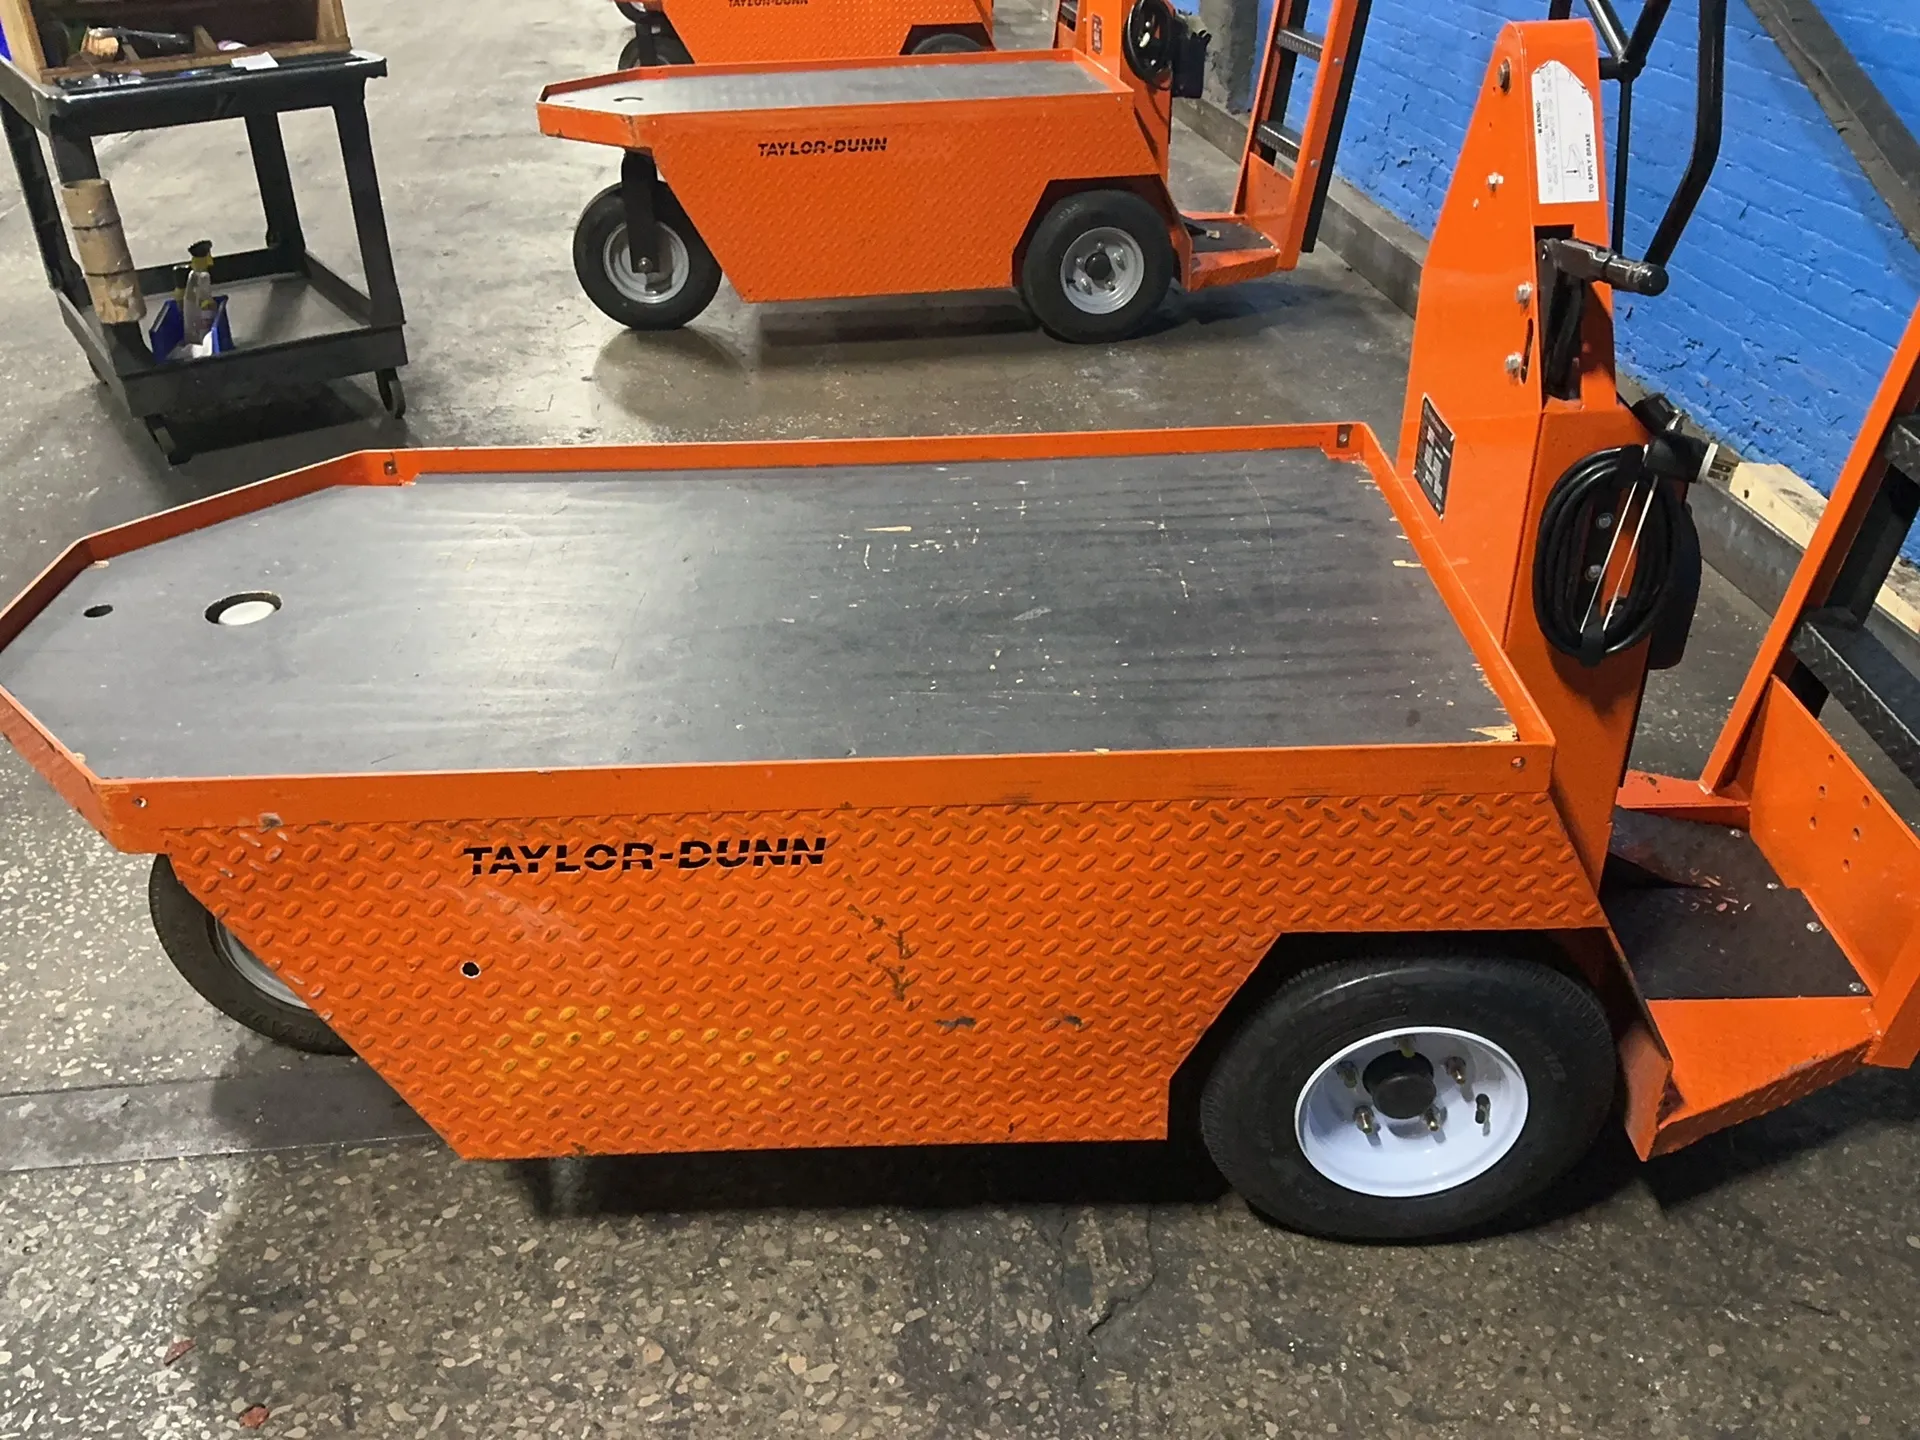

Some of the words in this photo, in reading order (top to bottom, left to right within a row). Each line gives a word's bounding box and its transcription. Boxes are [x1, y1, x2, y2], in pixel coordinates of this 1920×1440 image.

[758, 137, 887, 157] TAYLOR-DUNN
[1589, 184, 1594, 193] TO
[463, 837, 827, 876] TAYLOR-DUNN
